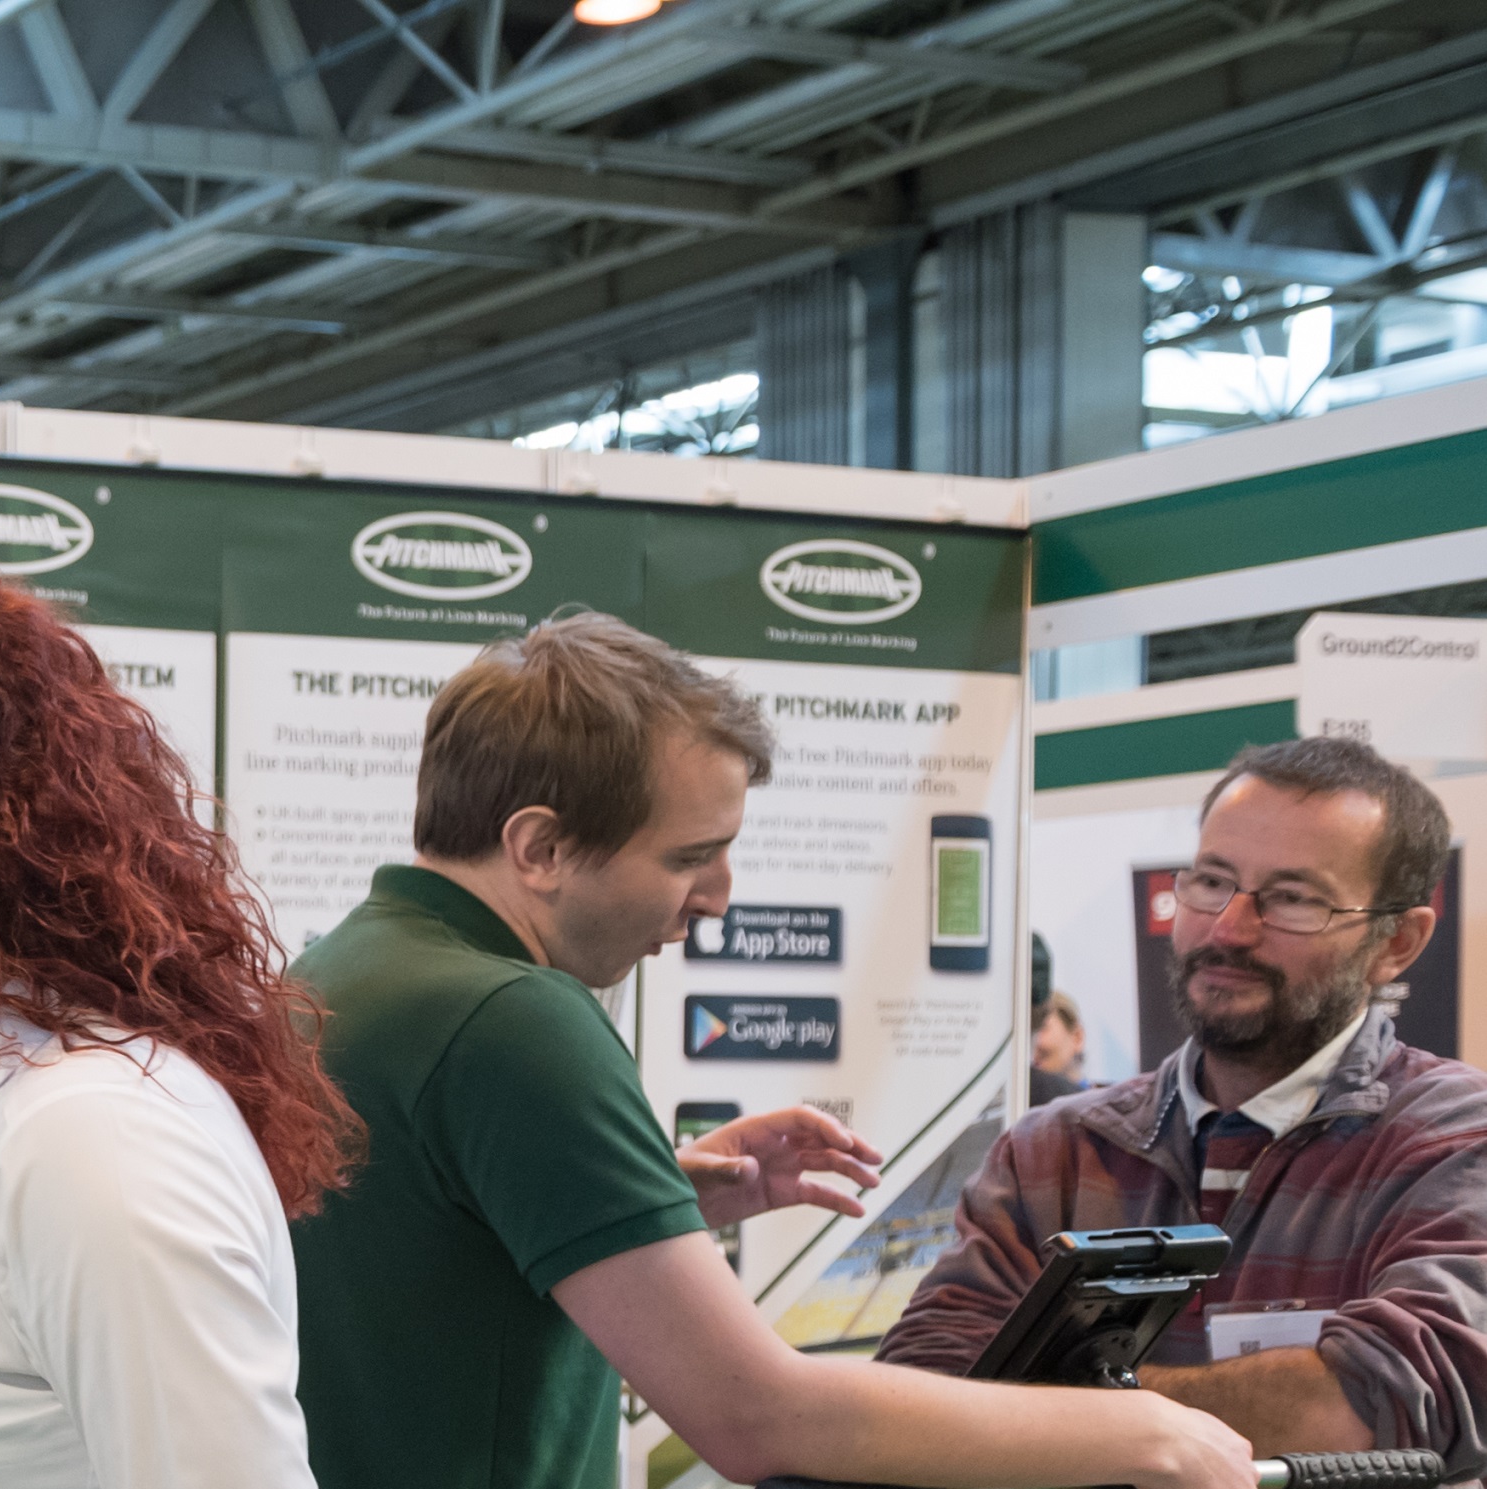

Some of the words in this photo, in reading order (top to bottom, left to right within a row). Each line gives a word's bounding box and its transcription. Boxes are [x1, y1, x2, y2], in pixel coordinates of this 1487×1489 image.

[374, 533, 512, 577] PITCHMARK
[783, 561, 903, 602] PITCHMARK
[1321, 630, 1480, 661] Ground2Control
[107, 662, 175, 688] STEM
[292, 669, 341, 696] THE
[352, 672, 444, 698] PITCHM
[775, 695, 906, 723] PITCHMARK
[915, 703, 961, 724] APP
[732, 928, 776, 960] App
[776, 928, 830, 956] Store
[730, 1015, 795, 1049] Google
[801, 1017, 835, 1047] play
